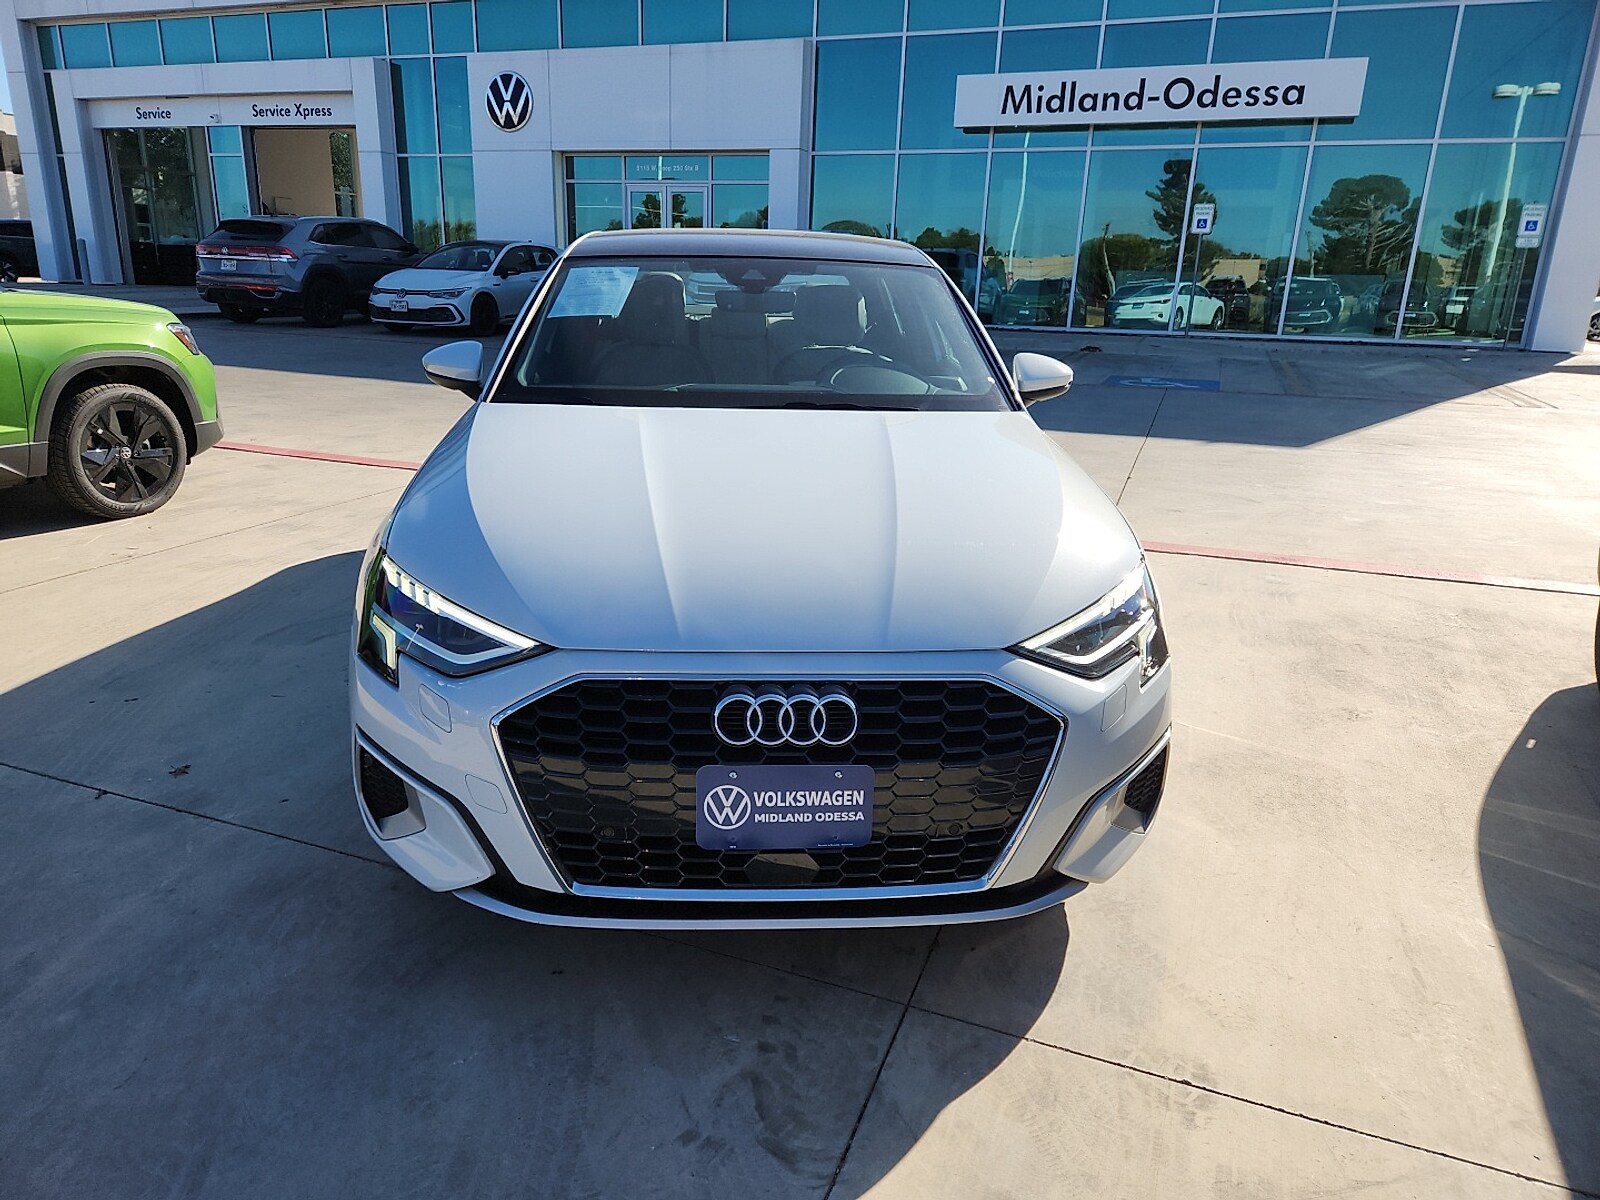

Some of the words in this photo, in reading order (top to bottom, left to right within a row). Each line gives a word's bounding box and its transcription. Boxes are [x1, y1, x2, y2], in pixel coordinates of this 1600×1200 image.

[1000, 75, 1306, 115] Midland-Odessa
[135, 107, 172, 120] Service
[252, 104, 291, 118] Service
[294, 103, 333, 121] Xpress
[753, 790, 865, 807] VOLKSWAGEN
[754, 813, 813, 823] MIDLAND
[814, 811, 865, 822] ODESSA
